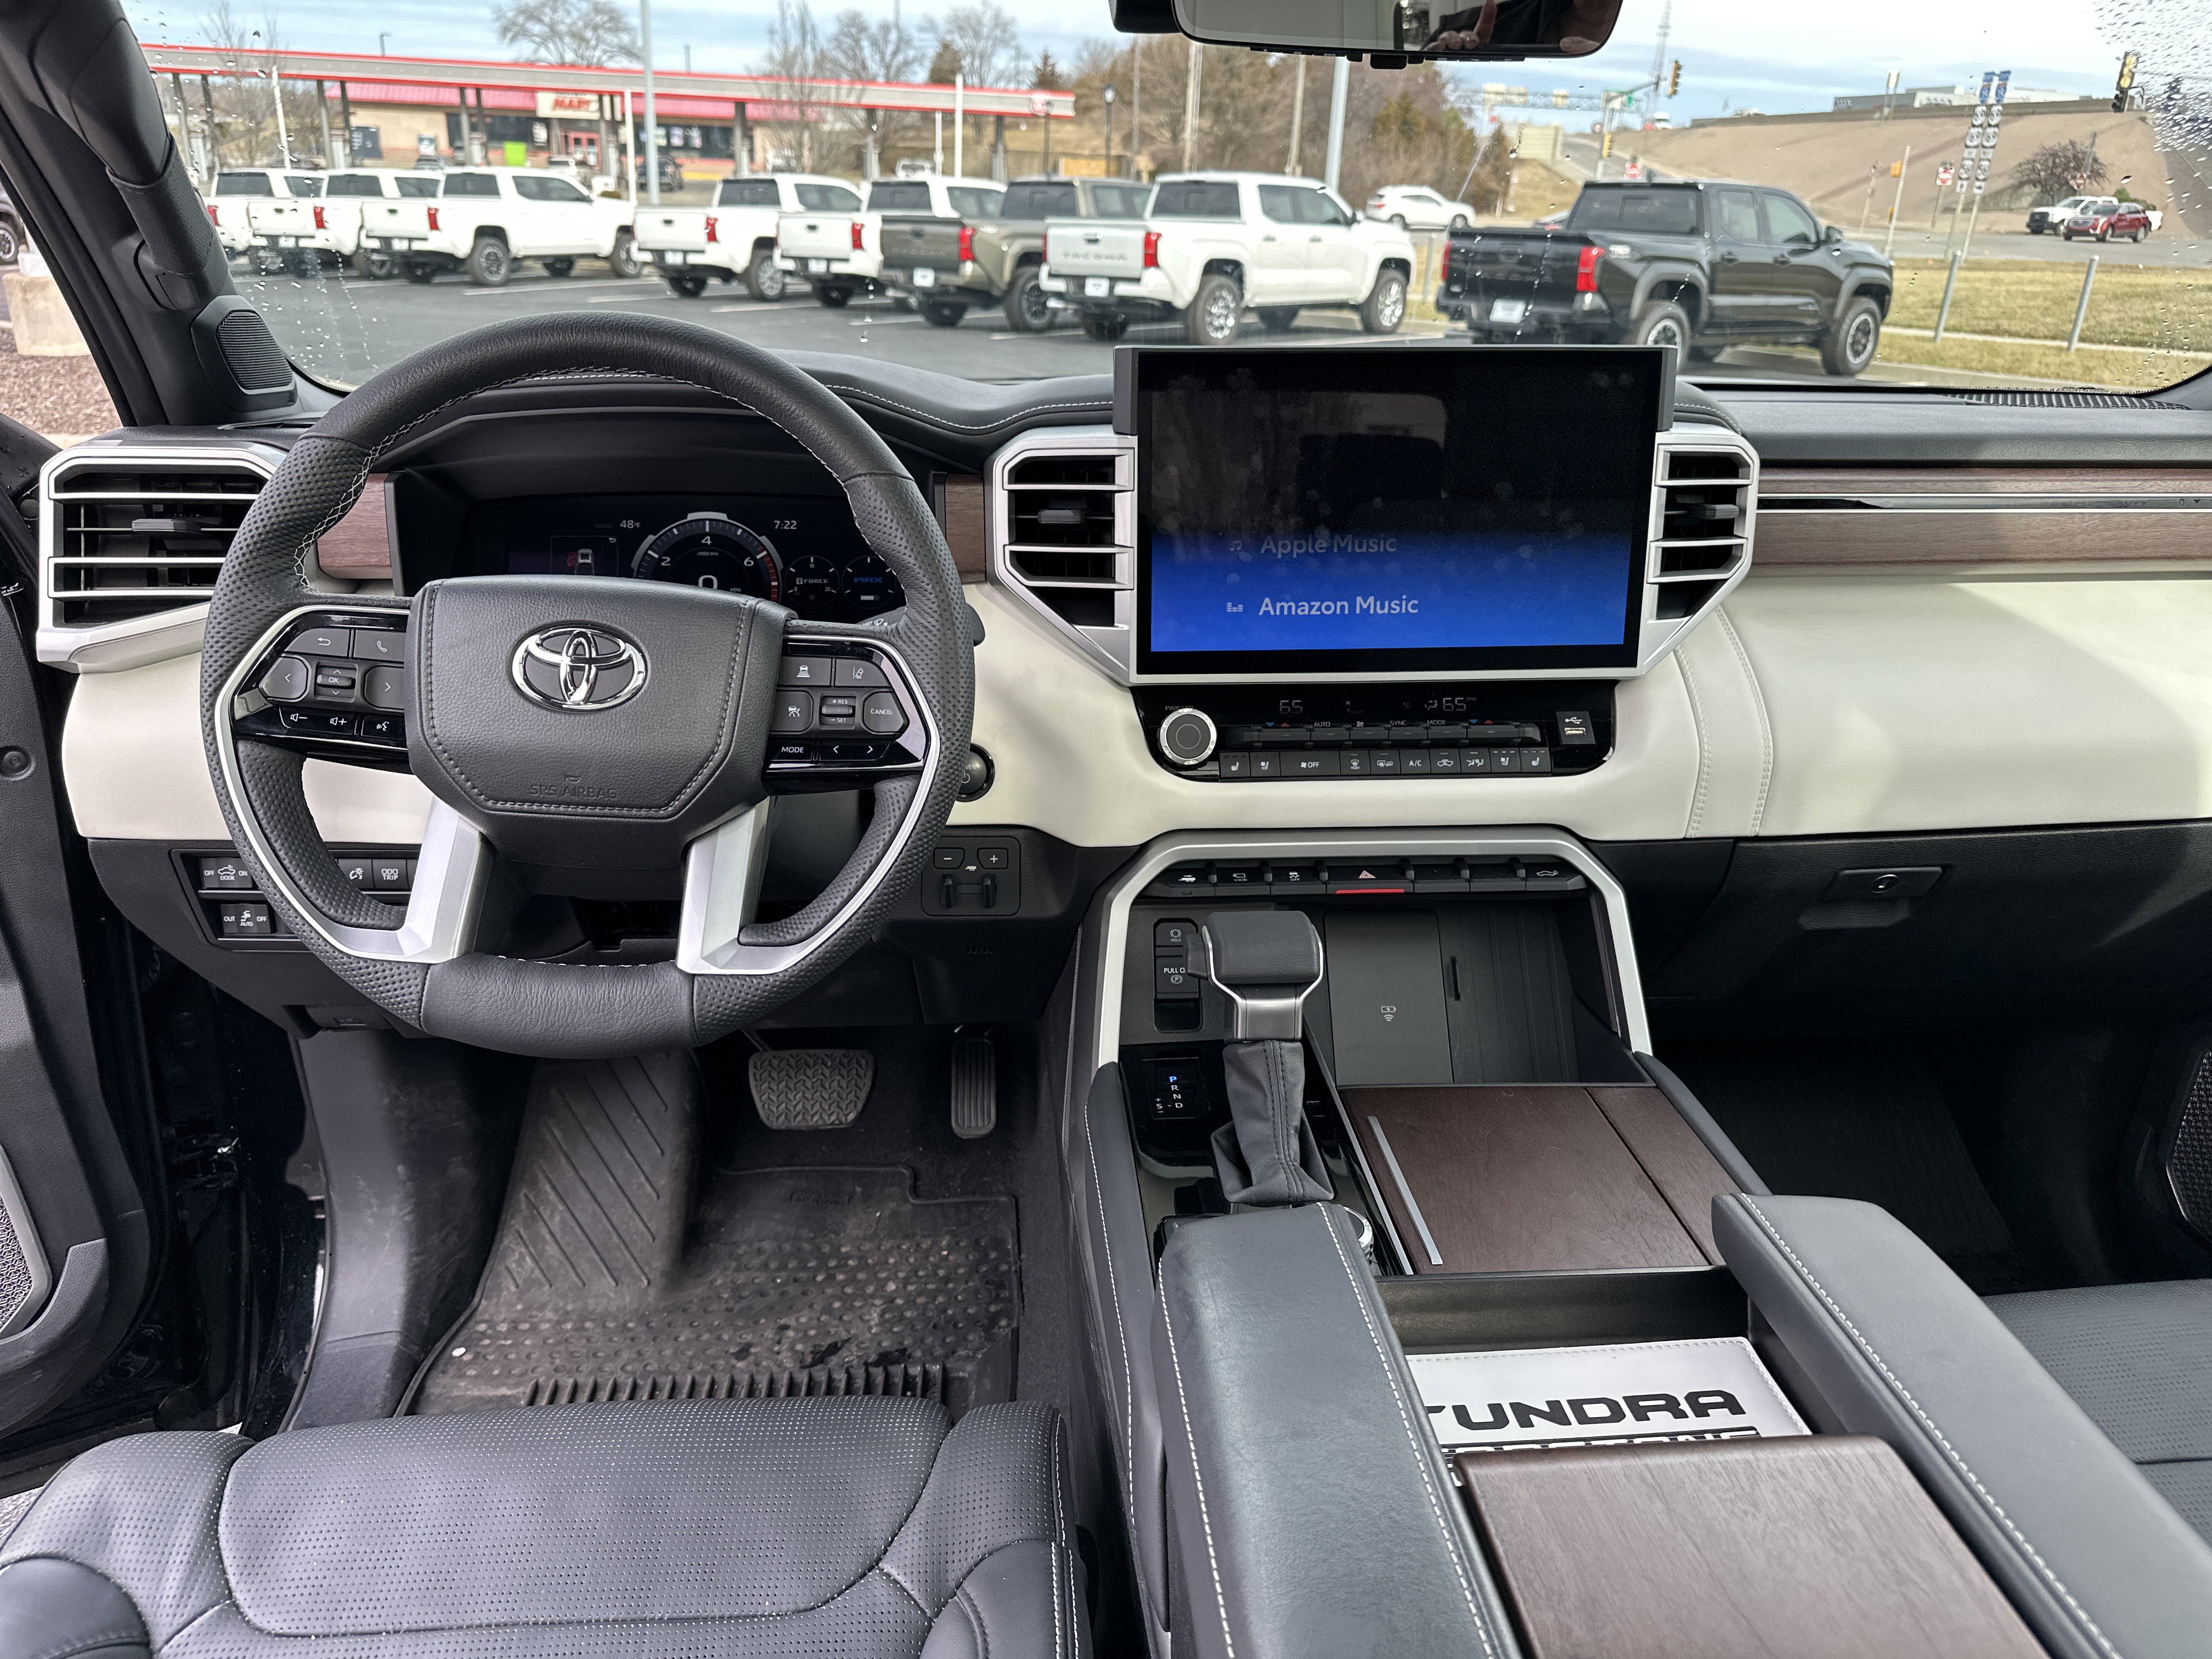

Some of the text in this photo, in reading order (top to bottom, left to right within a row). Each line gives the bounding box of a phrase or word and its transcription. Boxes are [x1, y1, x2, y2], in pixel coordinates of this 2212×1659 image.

[774, 521, 797, 529] 7:22
[701, 536, 712, 545] 4
[1261, 533, 1397, 558] Apple Music
[661, 556, 671, 566] 2
[743, 557, 754, 566] 6
[1259, 595, 1419, 616] Amazon Music
[1279, 699, 1303, 713] 65
[1442, 697, 1466, 712] 65
[530, 784, 558, 797] SRS
[1426, 1390, 1746, 1431] UNDRA
